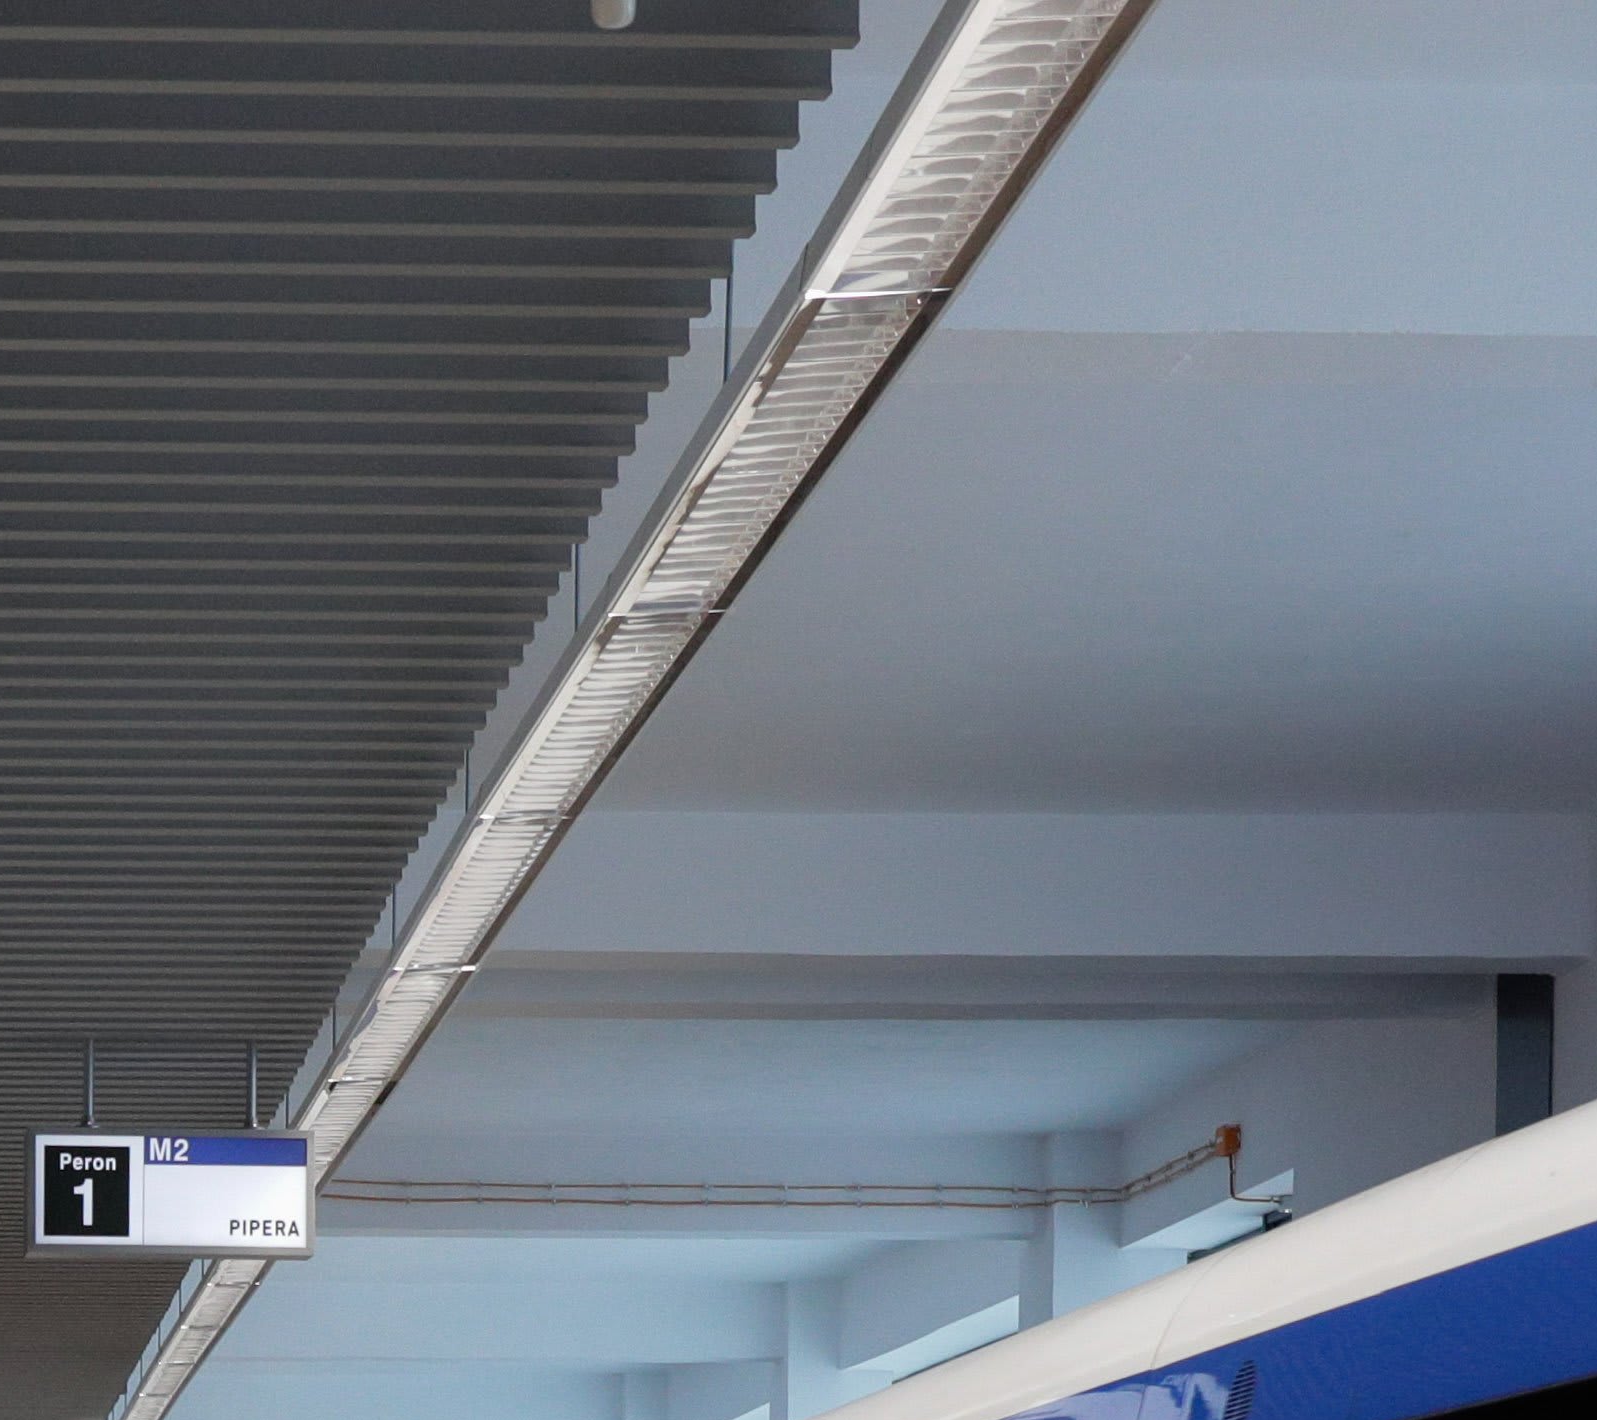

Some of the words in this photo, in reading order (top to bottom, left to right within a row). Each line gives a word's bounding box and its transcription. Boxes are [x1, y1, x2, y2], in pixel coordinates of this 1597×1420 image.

[149, 1138, 189, 1162] M2
[59, 1153, 116, 1171] Peron
[73, 1178, 93, 1226] 1
[229, 1219, 300, 1237] PIPERA
